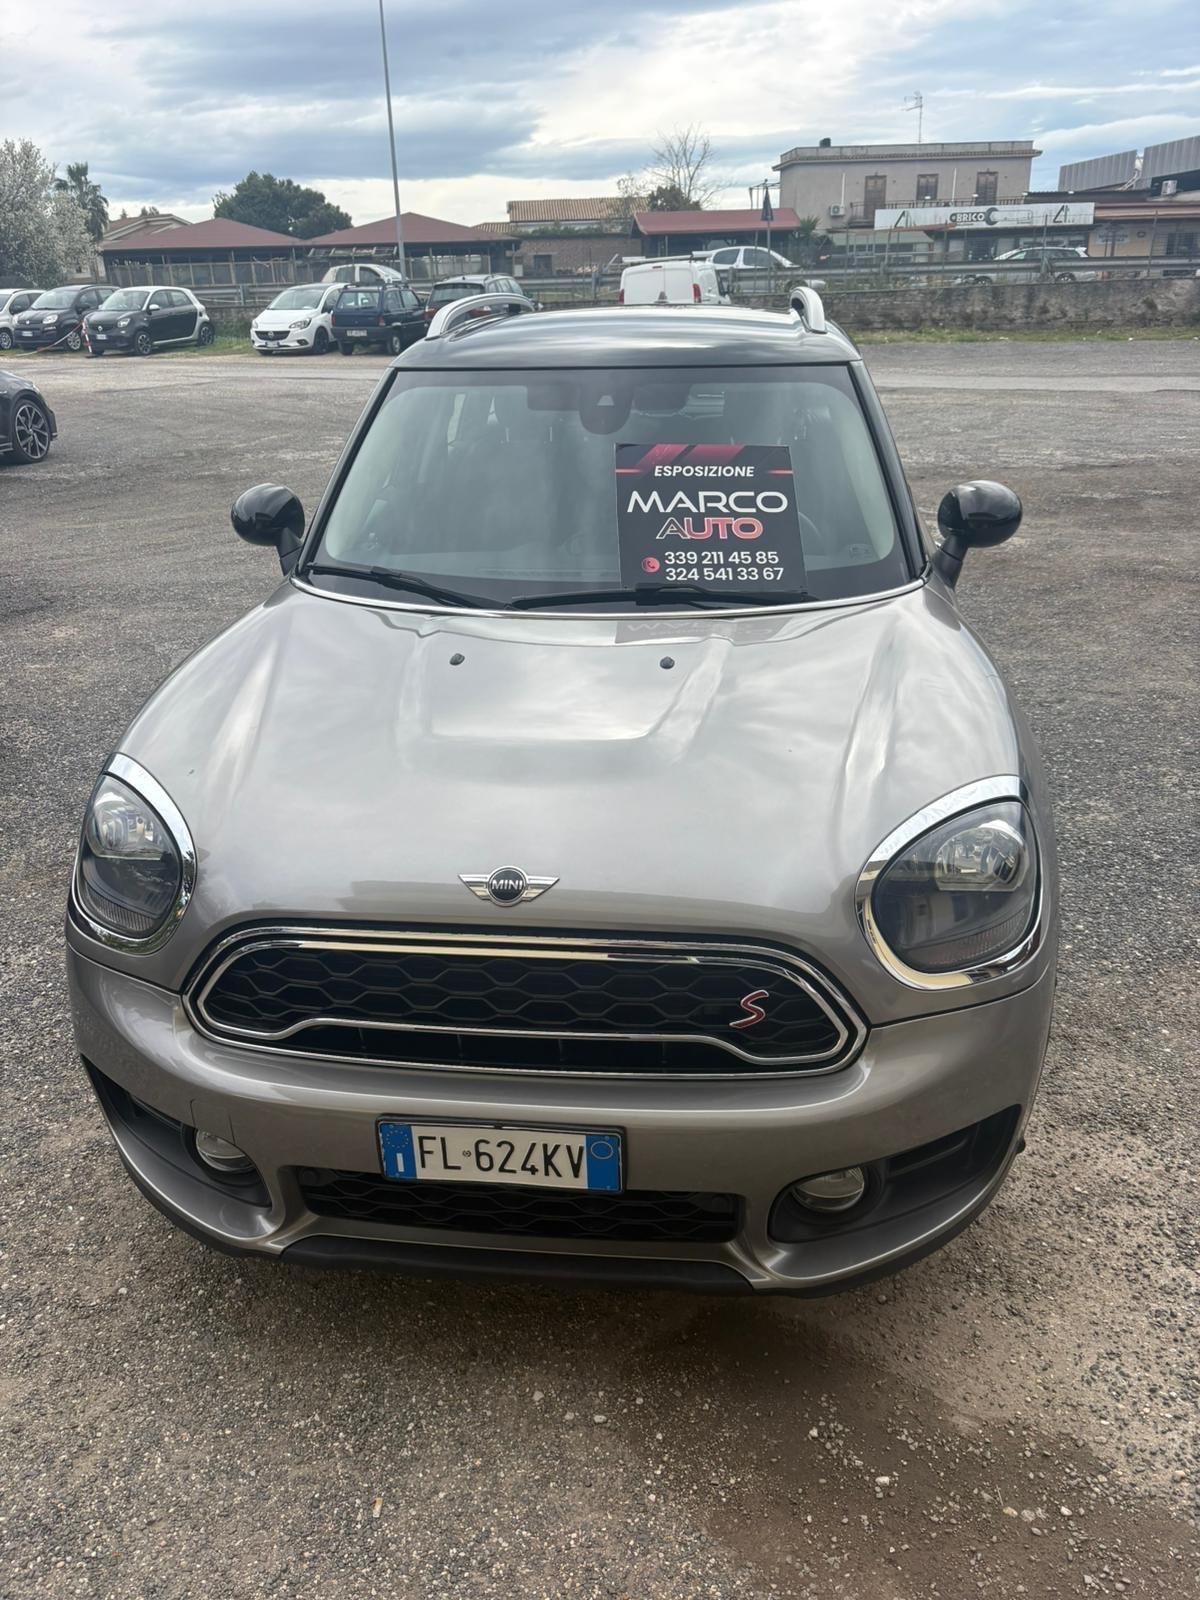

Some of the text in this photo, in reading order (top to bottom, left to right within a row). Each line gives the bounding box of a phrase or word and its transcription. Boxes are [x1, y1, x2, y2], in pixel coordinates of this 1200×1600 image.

[955, 212, 985, 222] BRICO
[654, 465, 755, 477] ESPOSIZIONE
[627, 490, 788, 513] MARCO
[656, 517, 763, 540] AUTO
[664, 551, 779, 565] 339 211 45 85
[665, 567, 784, 581] 324 541 33 67
[491, 879, 523, 890] MINI
[728, 989, 770, 1029] S
